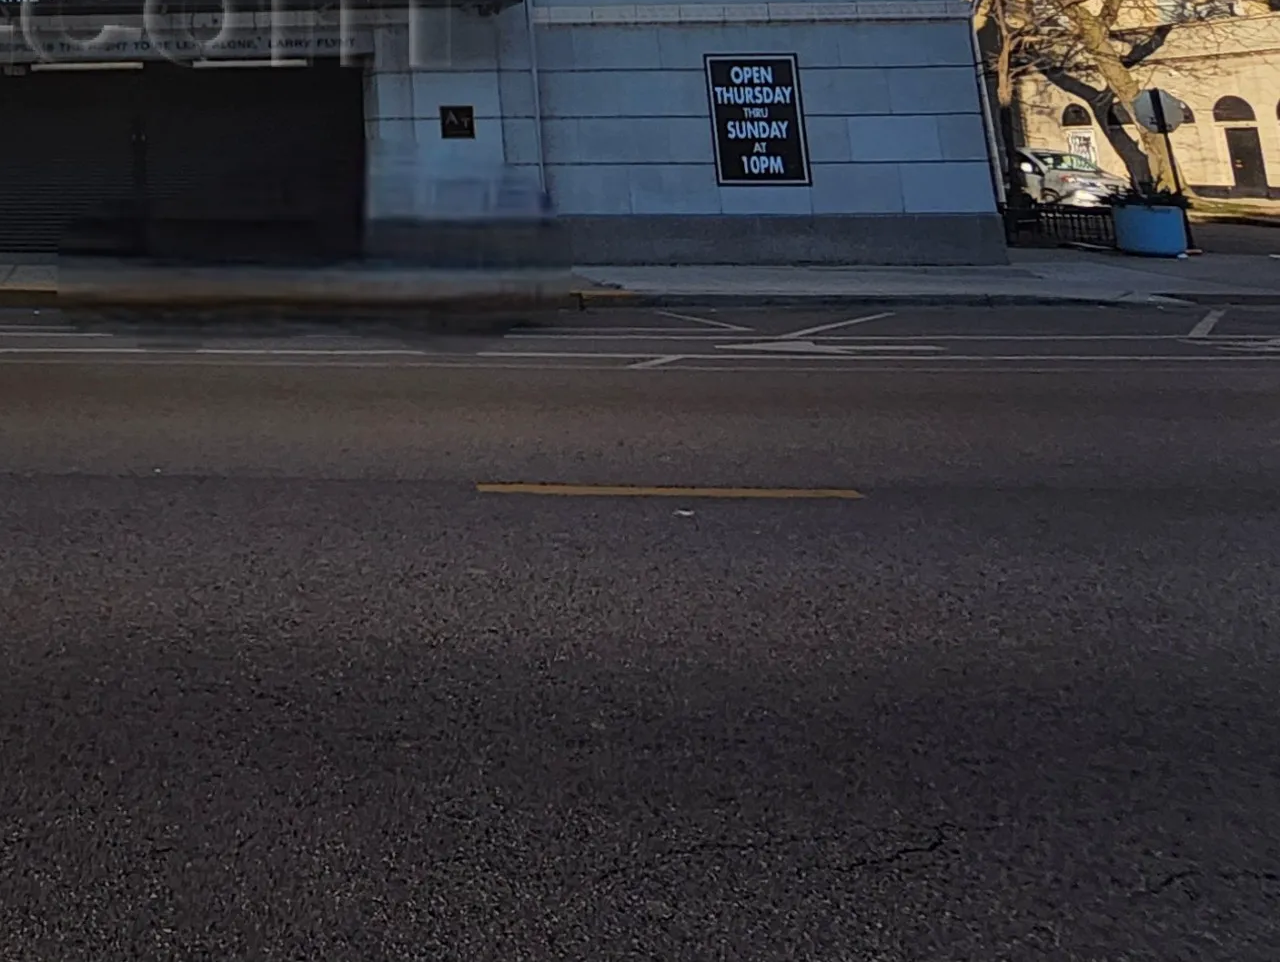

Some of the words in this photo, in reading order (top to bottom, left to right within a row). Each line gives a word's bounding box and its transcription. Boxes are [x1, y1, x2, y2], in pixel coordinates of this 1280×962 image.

[134, 40, 150, 50] TO
[730, 66, 773, 84] OPEN
[715, 86, 792, 104] THURSDAY
[743, 107, 768, 118] THRU
[727, 120, 788, 139] SUNDAY
[753, 142, 766, 153] AT
[742, 156, 784, 174] 10PM
